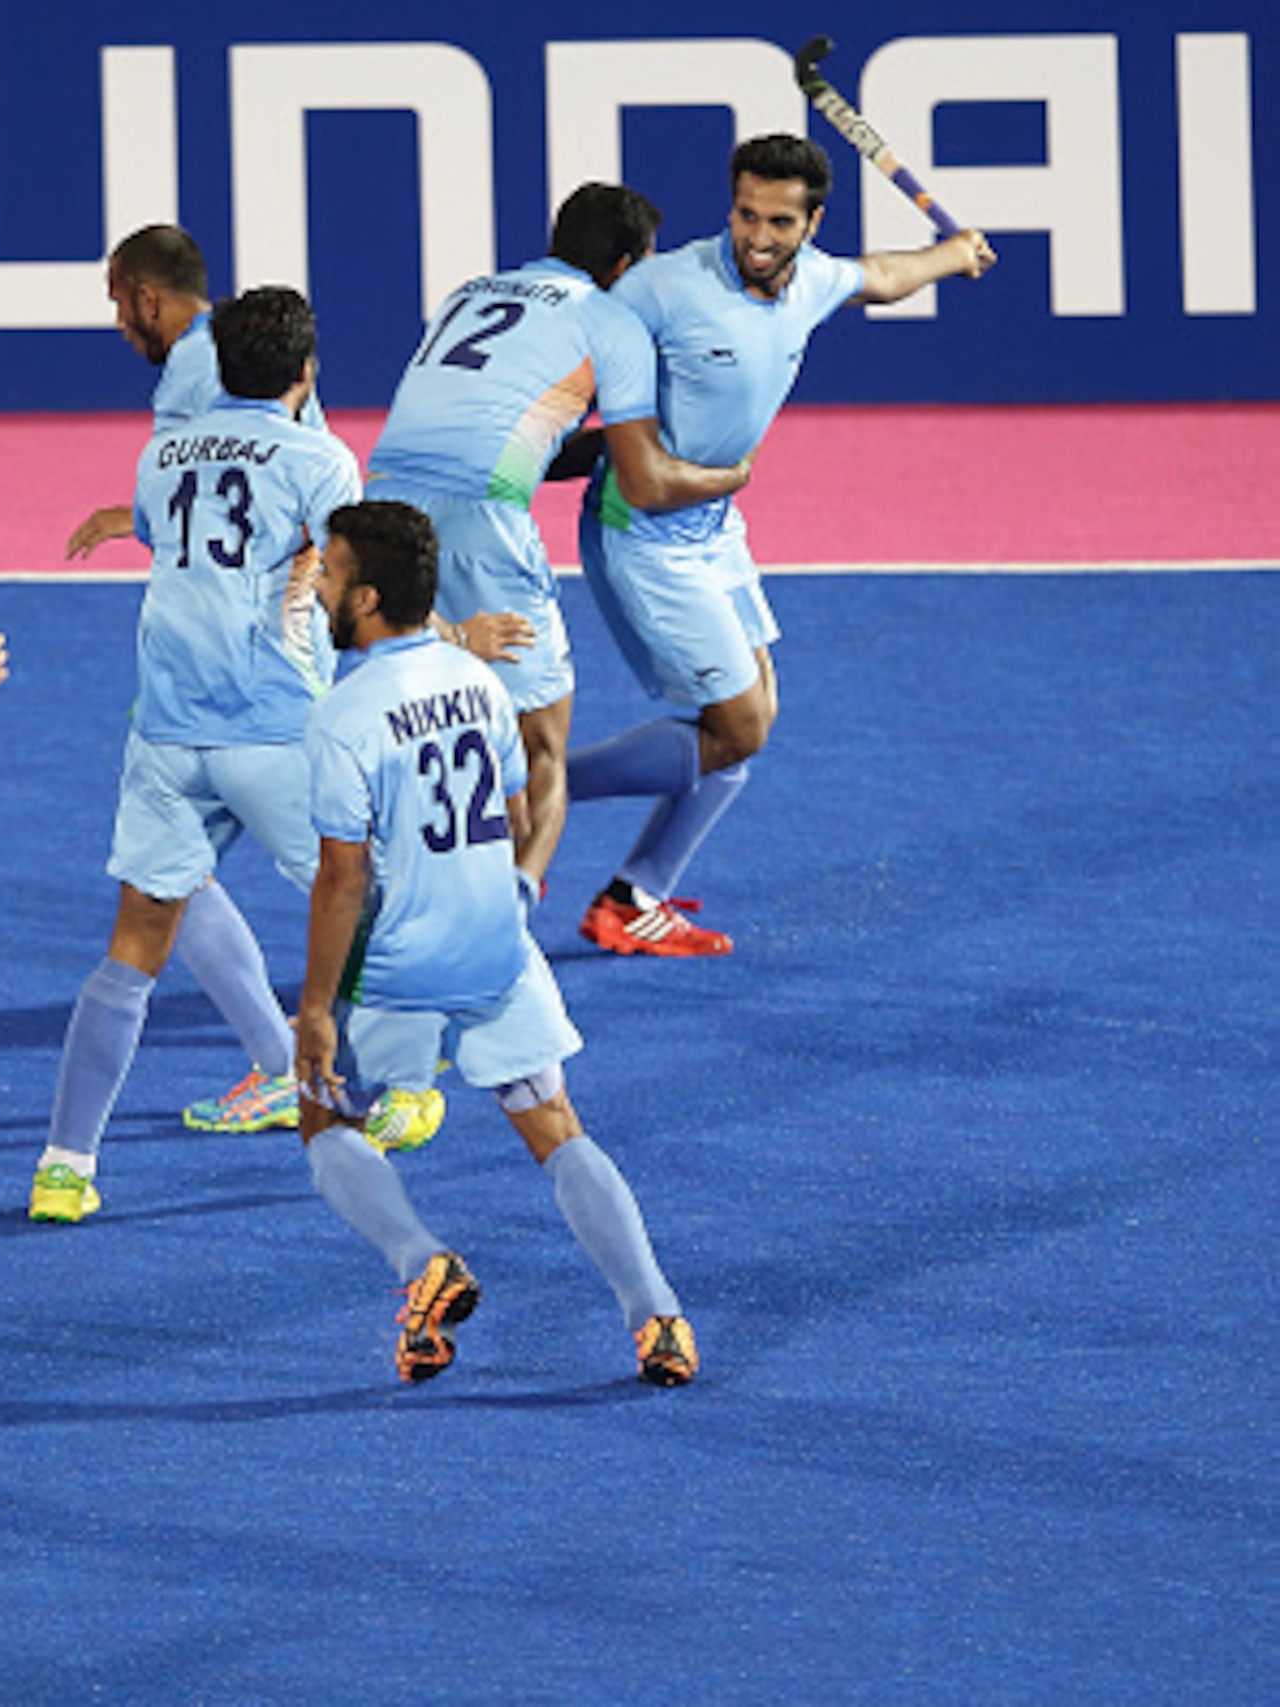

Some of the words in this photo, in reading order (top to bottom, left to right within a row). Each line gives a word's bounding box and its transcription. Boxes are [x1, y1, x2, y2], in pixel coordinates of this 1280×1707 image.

[417, 298, 526, 371] 12
[158, 435, 280, 469] GURBAJ
[168, 466, 253, 569] 13
[418, 729, 510, 854] 32
